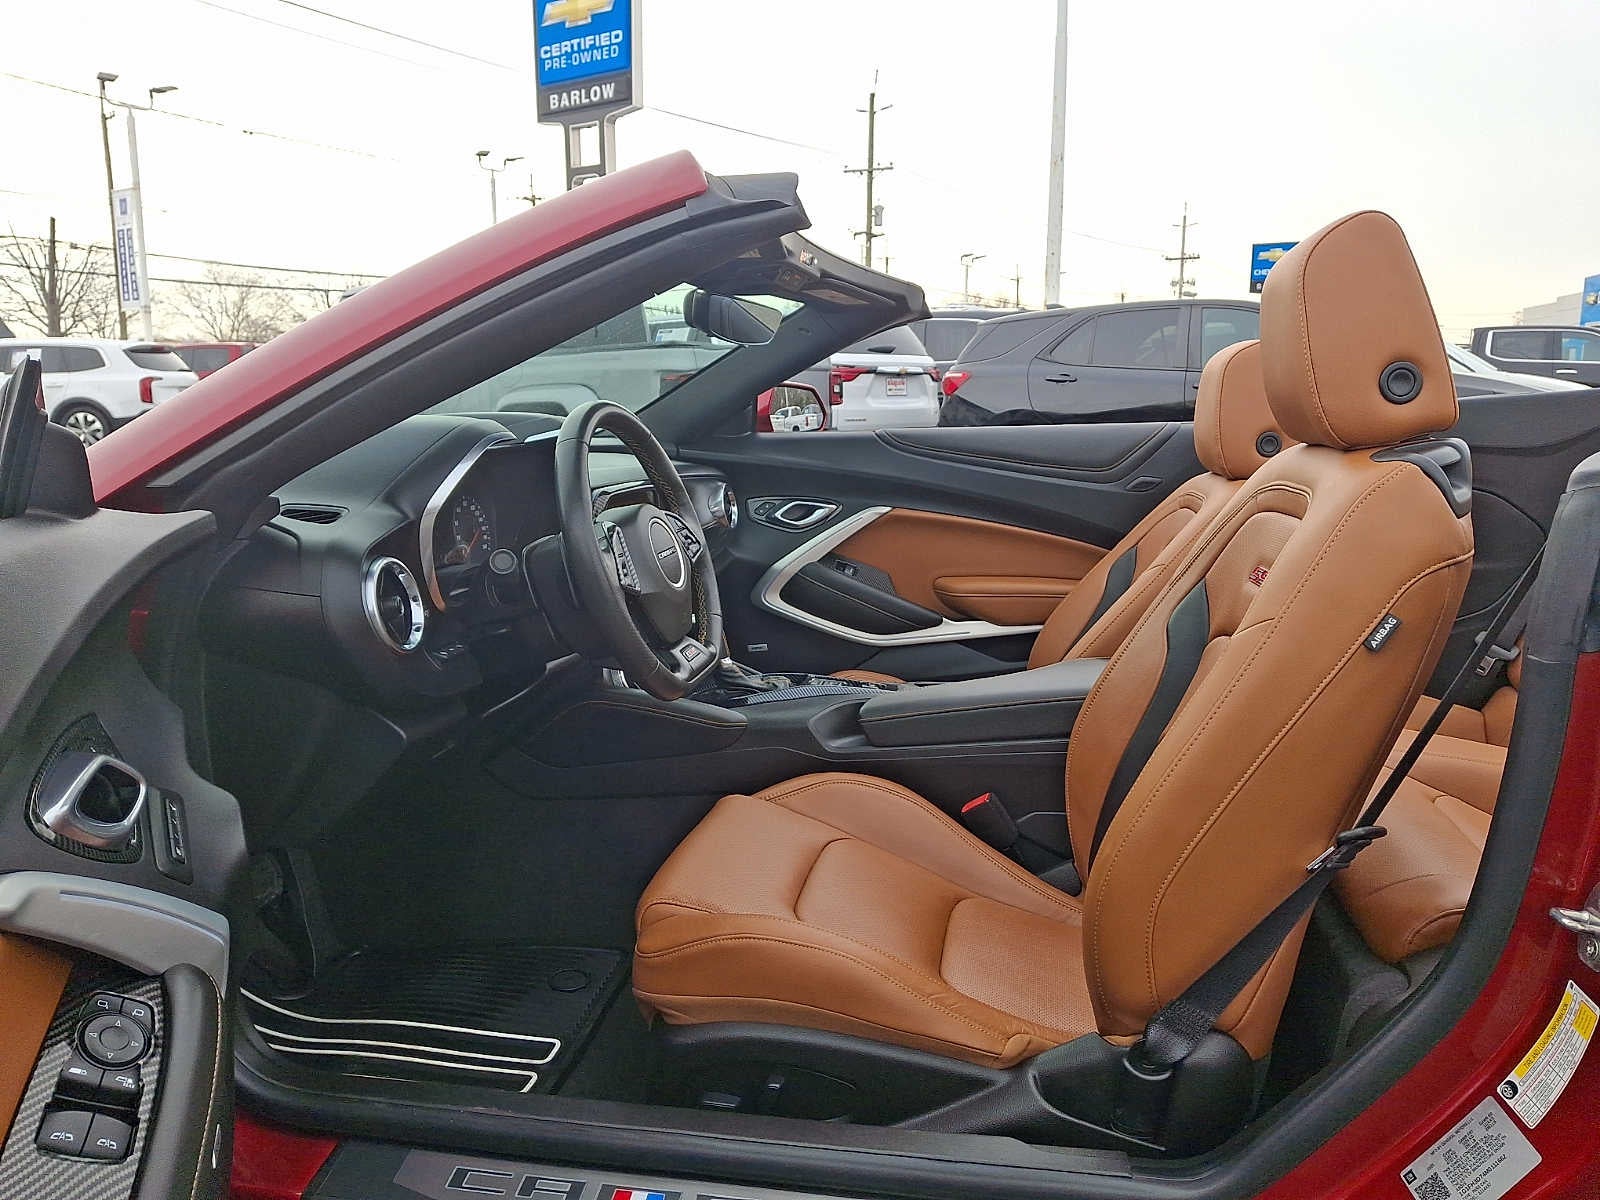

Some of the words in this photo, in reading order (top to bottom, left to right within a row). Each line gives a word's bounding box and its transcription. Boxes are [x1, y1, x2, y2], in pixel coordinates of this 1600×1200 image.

[540, 29, 623, 59] CERTIFIED
[544, 45, 619, 71] PRE-OWNED
[549, 82, 615, 110] BARLOW
[1370, 617, 1397, 648] AIRBAG
